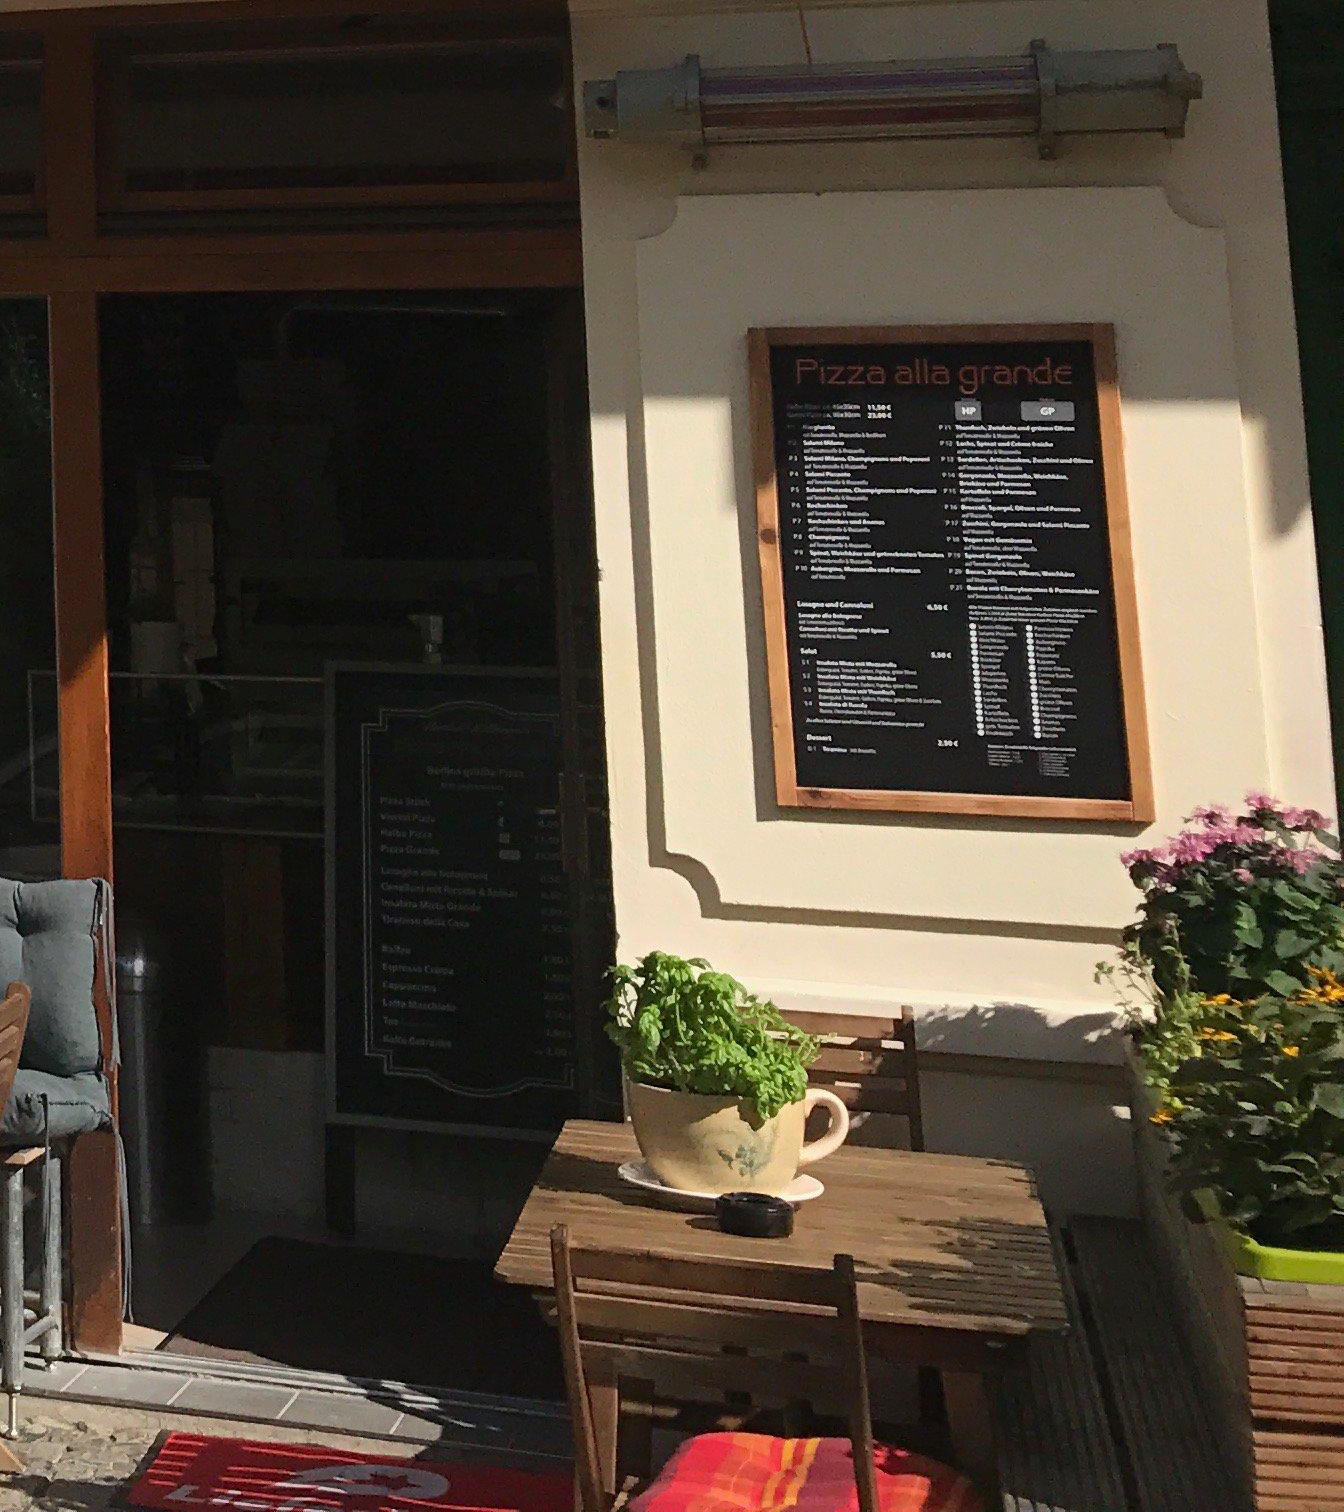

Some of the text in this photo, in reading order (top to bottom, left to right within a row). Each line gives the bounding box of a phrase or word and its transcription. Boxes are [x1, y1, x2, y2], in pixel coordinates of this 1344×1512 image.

[795, 356, 1072, 395] Pizza alla grande
